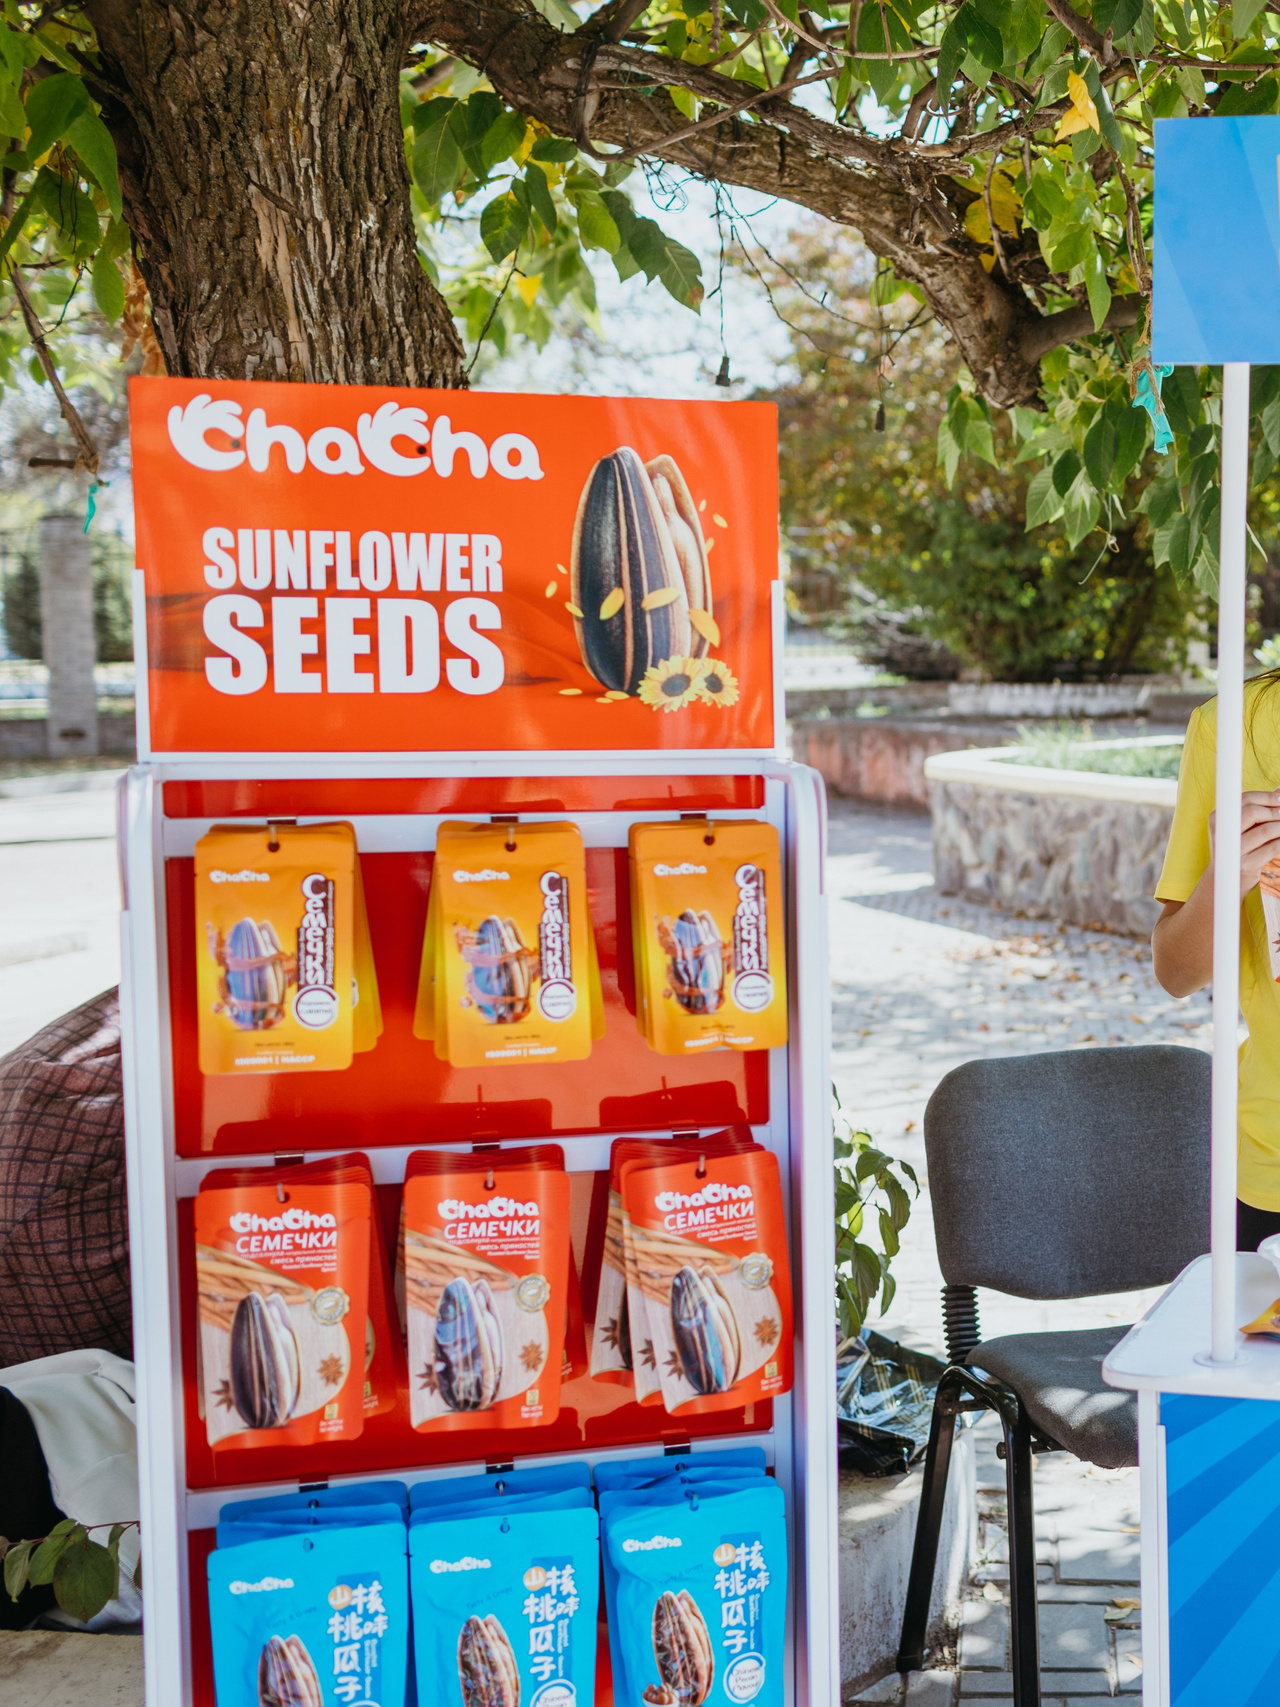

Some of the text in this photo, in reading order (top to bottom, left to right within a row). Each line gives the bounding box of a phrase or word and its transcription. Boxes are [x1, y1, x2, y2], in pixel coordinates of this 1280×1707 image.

[167, 394, 545, 480] ChaCha
[202, 526, 504, 592] SUNFLOWER
[202, 593, 505, 695] SEEDS
[209, 870, 270, 884] ChaCha
[452, 869, 511, 883] ChaCha
[653, 862, 708, 877] ChaCha
[540, 871, 563, 979] Семечки
[735, 864, 760, 970] Семечки
[302, 873, 327, 986] Семечки
[437, 1196, 540, 1220] ChaCha
[654, 1183, 753, 1212] ChaCha
[229, 1208, 337, 1233] ChaCha
[664, 1200, 754, 1231] СЕМЕЧКИ
[443, 1219, 540, 1239] СЕМЕЧКИ
[236, 1231, 338, 1253] СЕМЕЧКИ
[622, 1535, 683, 1553] ChaCha
[429, 1556, 492, 1574] ChaCha
[229, 1576, 295, 1595] ChaCha
